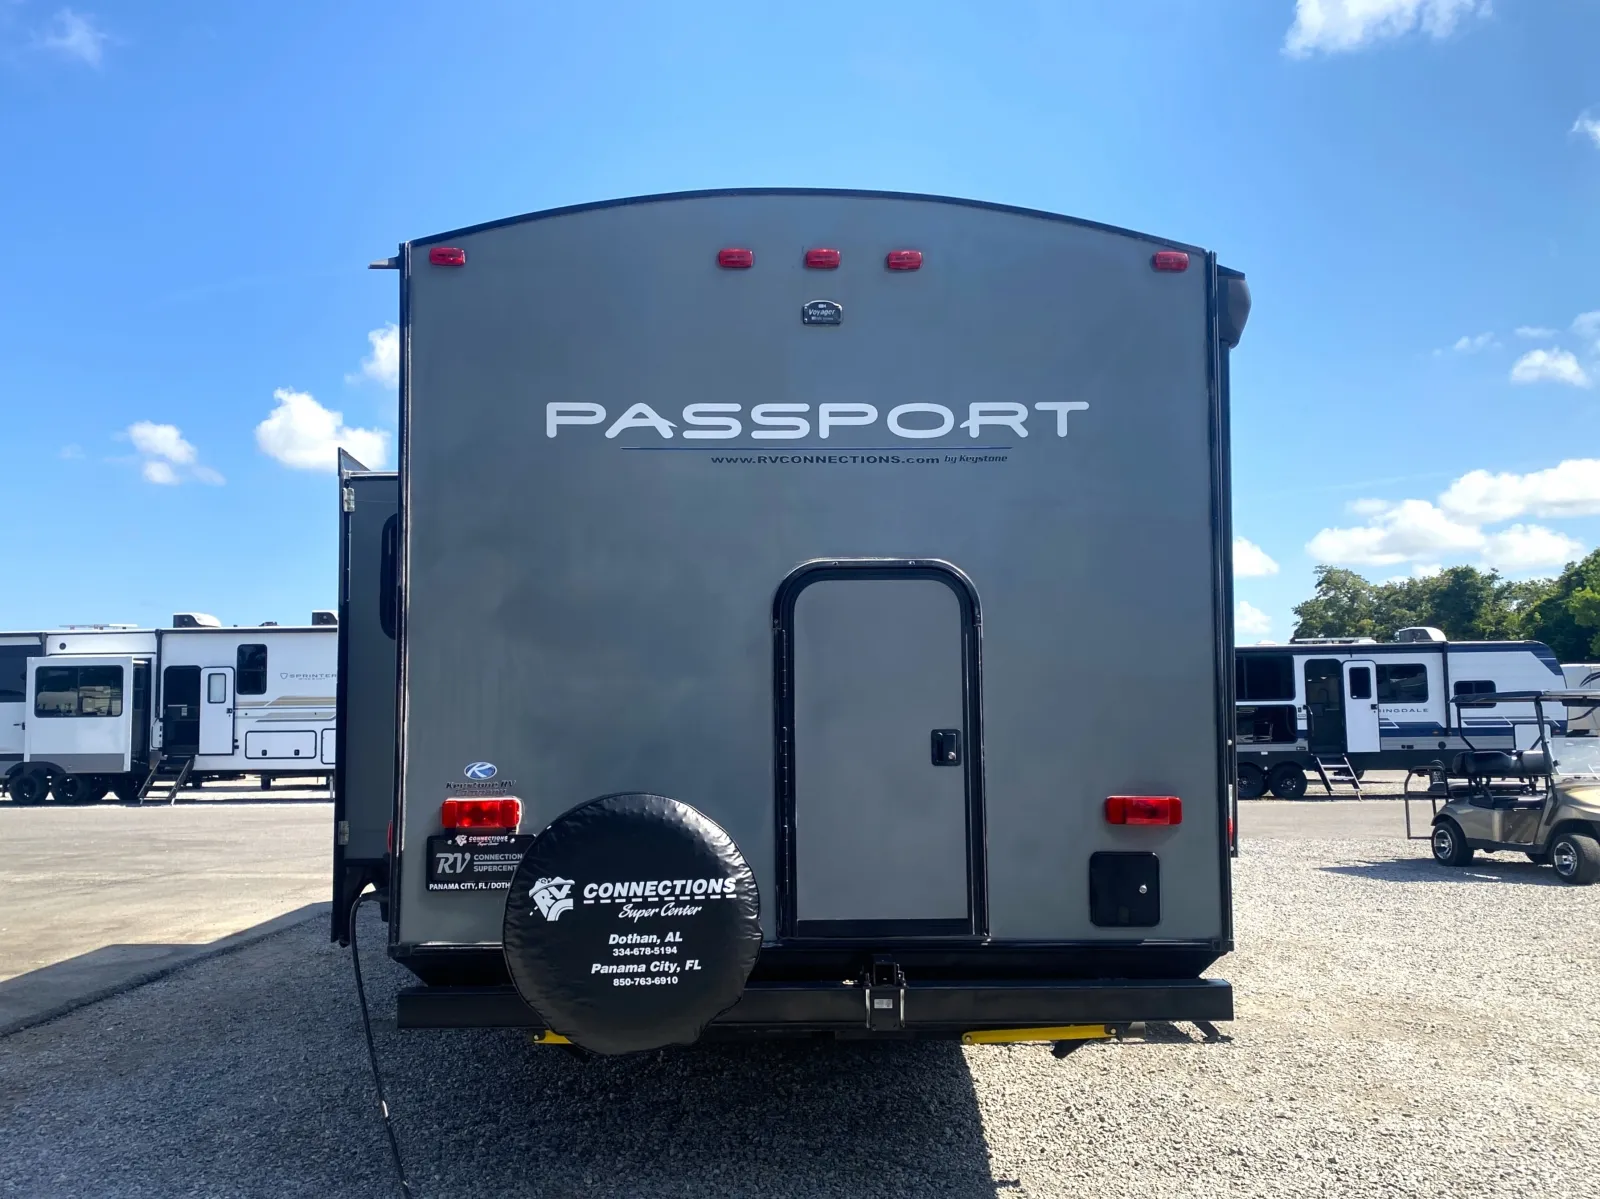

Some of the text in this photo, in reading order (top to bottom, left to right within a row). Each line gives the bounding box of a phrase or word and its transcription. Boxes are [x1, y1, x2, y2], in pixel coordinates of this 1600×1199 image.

[546, 401, 1090, 439] PASSPORT
[710, 454, 940, 465] www.RVCONNECTIONS.com
[944, 454, 1008, 464] by Keystone
[435, 852, 471, 874] RV
[460, 882, 478, 890] CITY,
[583, 877, 737, 900] CONNECTIONS
[618, 901, 702, 923] Super Center
[608, 931, 683, 945] Dothan, AL
[612, 945, 678, 957] 334-678-5194
[590, 959, 702, 975] Panama City, FL
[612, 976, 679, 987] 850-763-6910
